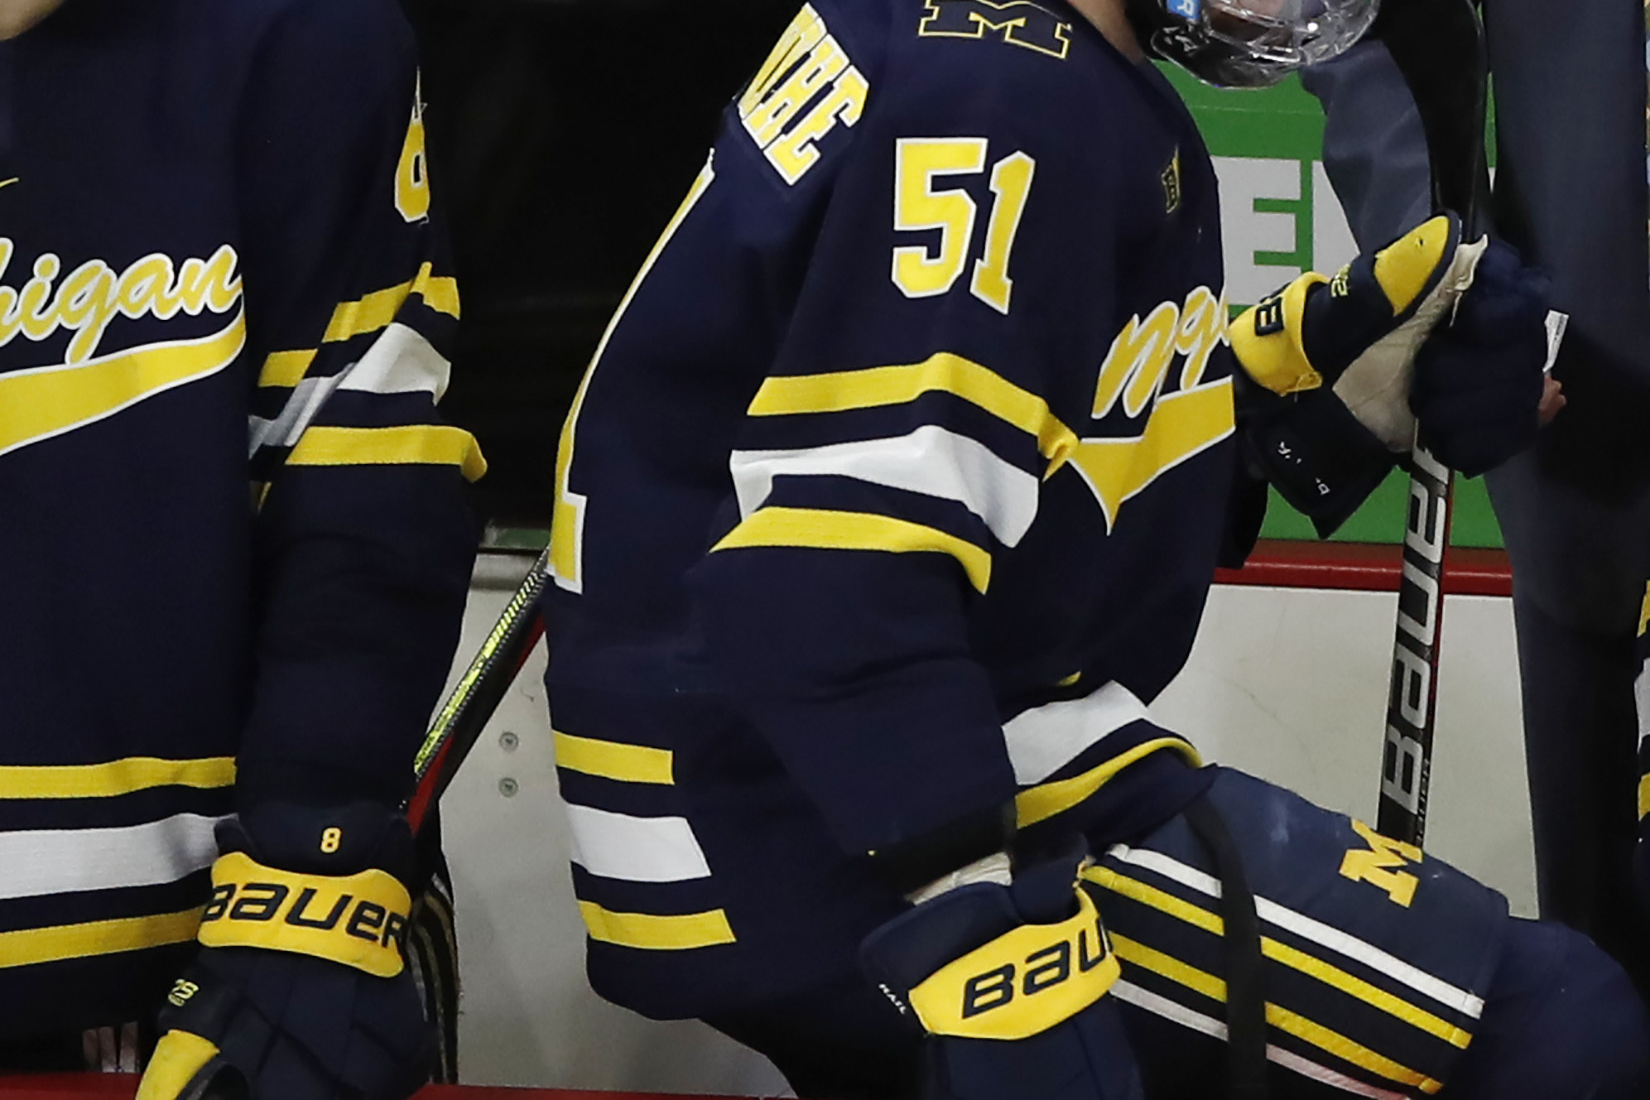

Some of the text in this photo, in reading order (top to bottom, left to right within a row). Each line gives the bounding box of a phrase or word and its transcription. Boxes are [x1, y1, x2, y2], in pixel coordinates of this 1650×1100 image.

[891, 137, 1036, 315] 51
[320, 827, 342, 854] 8
[1339, 818, 1424, 909] M
